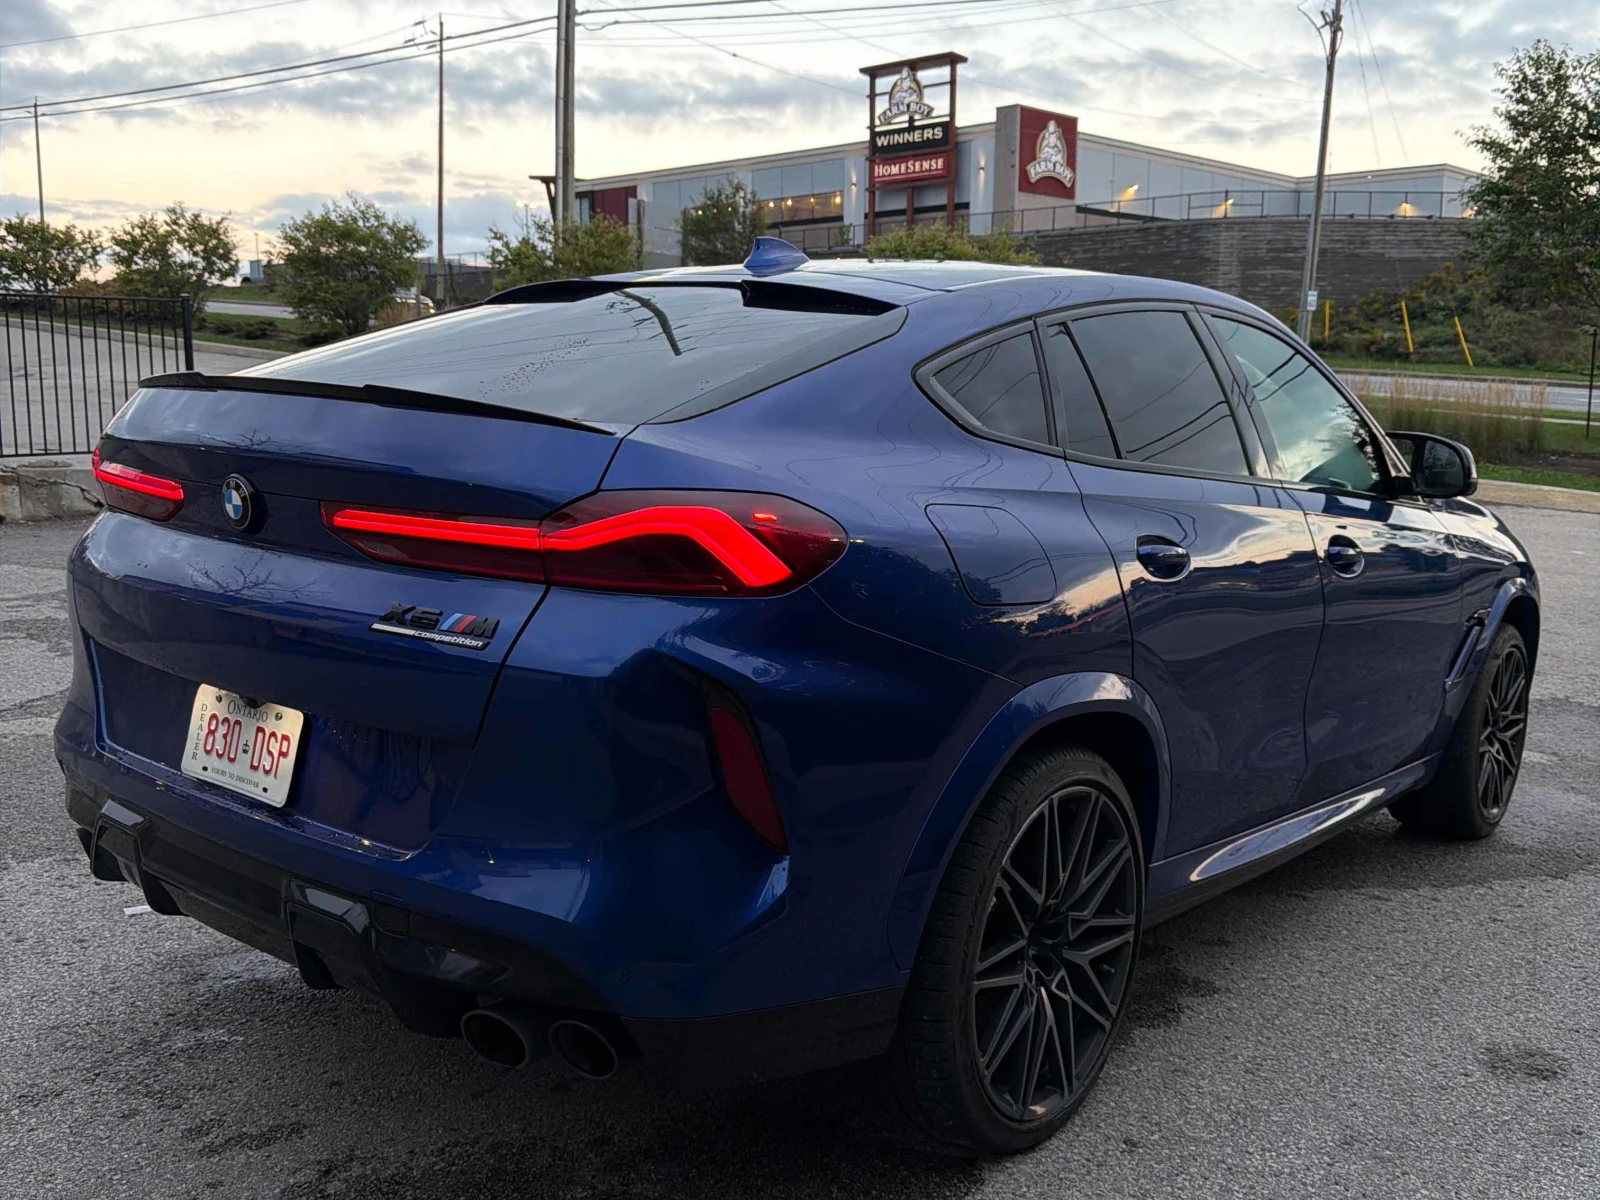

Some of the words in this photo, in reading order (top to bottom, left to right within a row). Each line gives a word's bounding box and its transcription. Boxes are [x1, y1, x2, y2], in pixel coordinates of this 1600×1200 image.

[880, 102, 908, 123] FARM
[909, 102, 931, 116] BOY
[876, 127, 943, 147] WINNERS
[874, 158, 944, 177] HOMESENSE
[1030, 160, 1054, 178] FARM
[414, 630, 483, 648] competition
[227, 700, 268, 723] ONTARIO
[191, 703, 208, 761] DEALER
[203, 712, 243, 763] 830
[249, 725, 291, 780] DSP
[211, 766, 228, 778] YOURS
[235, 775, 260, 789] DISCOVER
